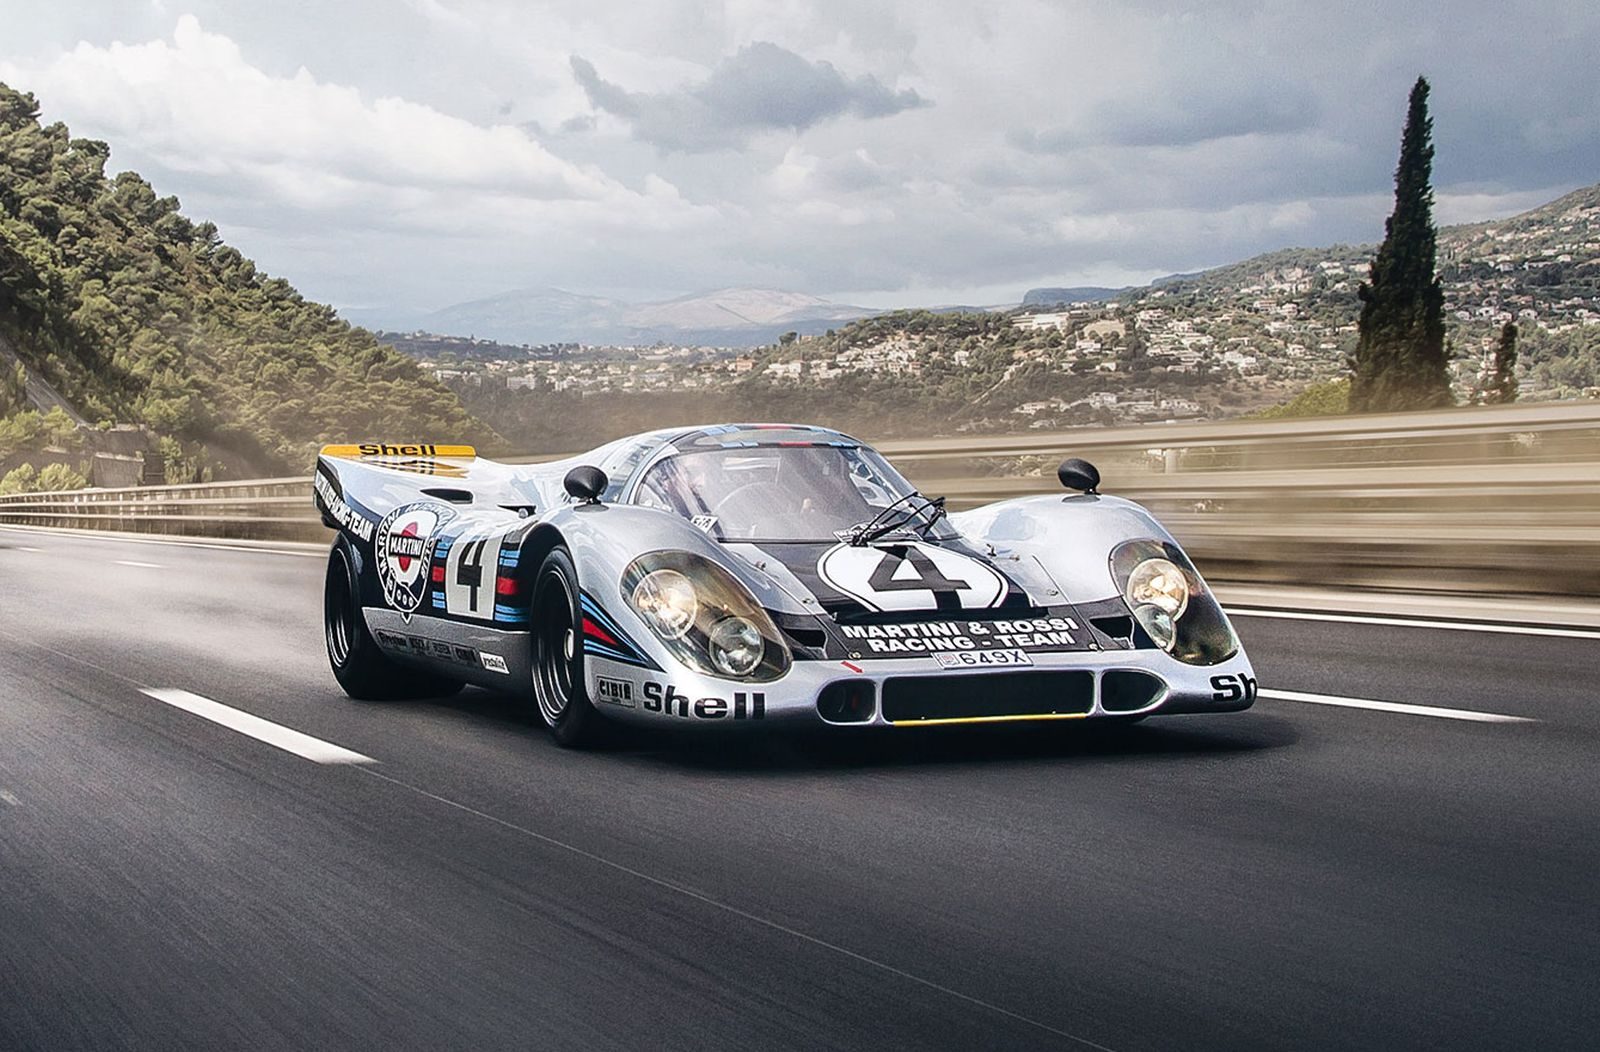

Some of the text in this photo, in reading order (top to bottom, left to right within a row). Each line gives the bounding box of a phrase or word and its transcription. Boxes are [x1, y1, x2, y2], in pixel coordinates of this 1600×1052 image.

[359, 444, 436, 455] Shell
[390, 536, 424, 556] MARTINI
[457, 539, 488, 612] 4
[868, 544, 973, 609] 4
[841, 617, 1079, 639] MARTINI & ROSSI
[866, 637, 975, 652] RACING
[1001, 632, 1075, 649] TEAM
[959, 650, 1027, 665] 649X
[643, 681, 766, 720] Shell
